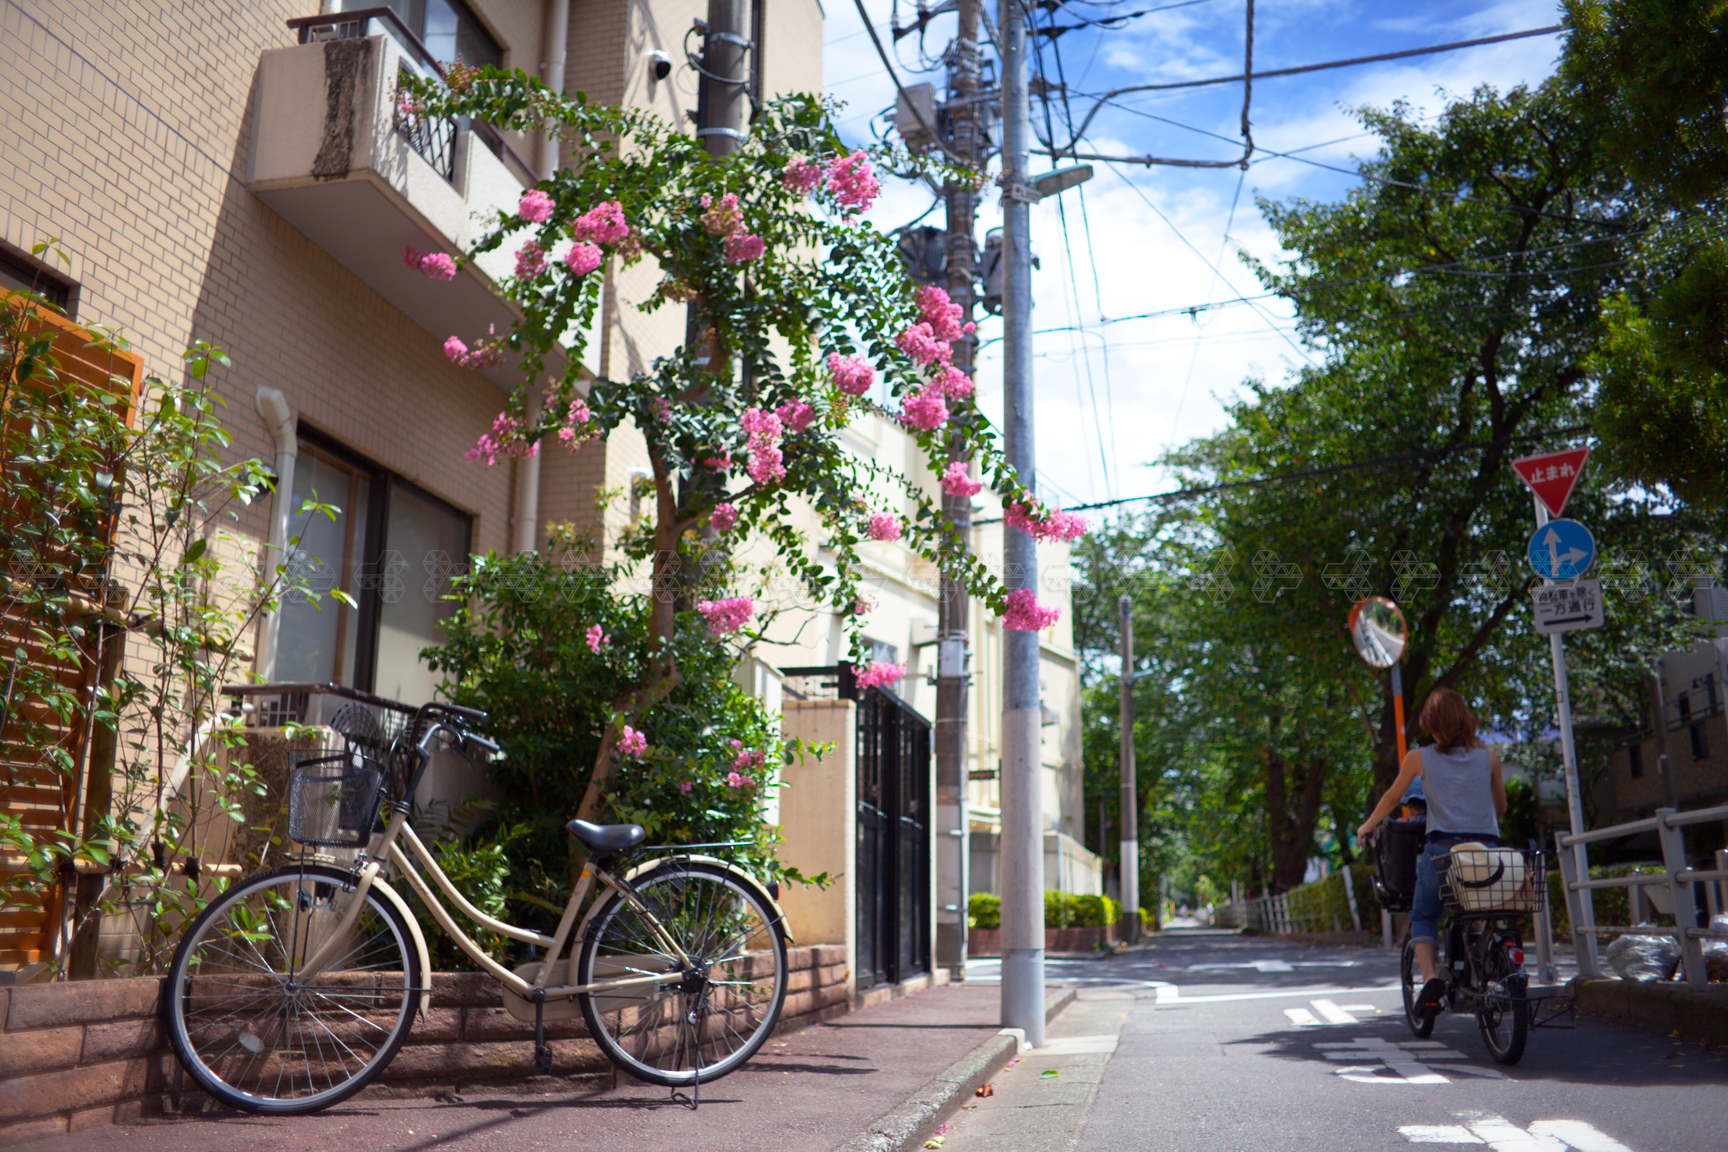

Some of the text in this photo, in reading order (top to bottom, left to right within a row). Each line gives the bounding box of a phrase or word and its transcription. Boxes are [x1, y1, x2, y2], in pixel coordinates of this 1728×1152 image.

[1530, 462, 1576, 484] 止まれ
[1540, 600, 1595, 615] 一方通行
